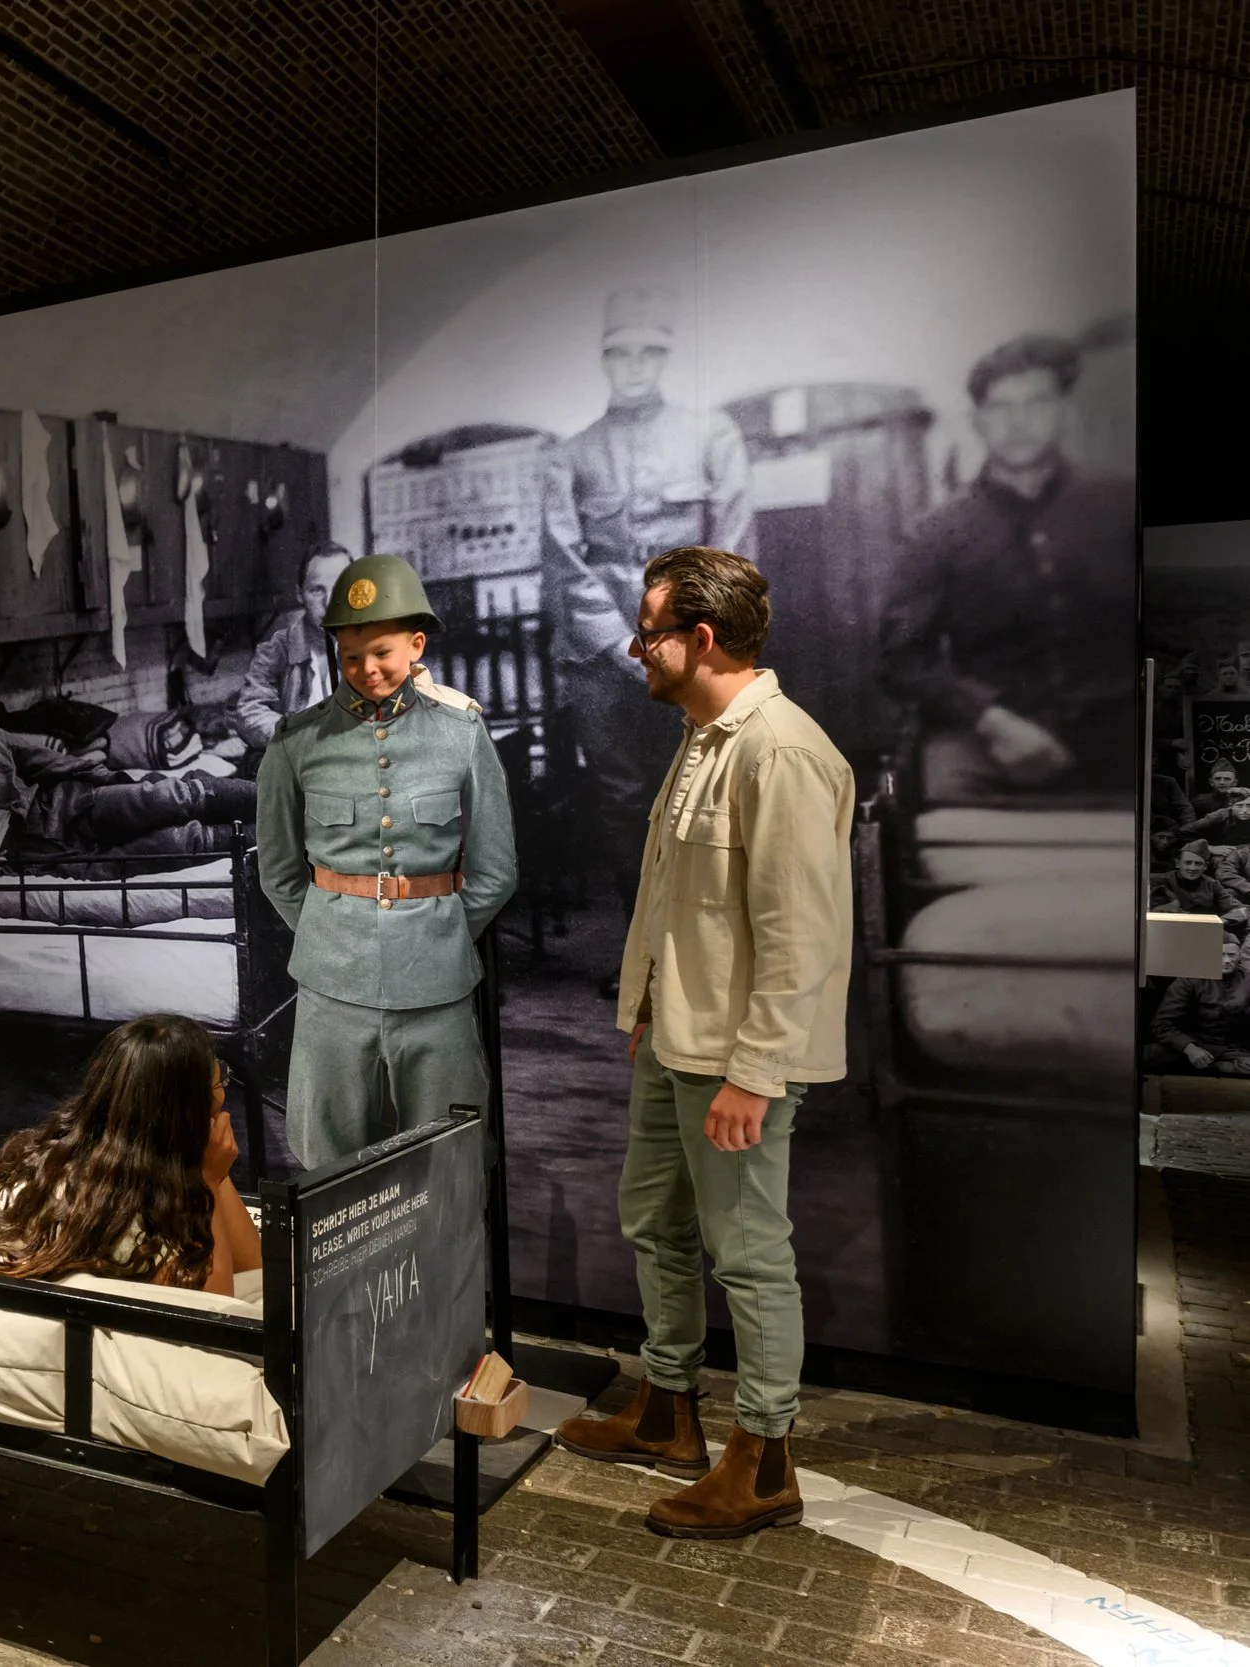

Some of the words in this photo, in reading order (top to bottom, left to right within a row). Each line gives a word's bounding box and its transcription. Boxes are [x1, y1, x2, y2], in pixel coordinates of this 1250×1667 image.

[312, 1208, 348, 1238] SCHRIJF
[348, 1200, 367, 1220] HIER
[368, 1194, 378, 1210] JE
[379, 1183, 401, 1204] NAAM
[346, 1220, 370, 1244] WRITE
[371, 1210, 390, 1231] YOUR
[391, 1200, 410, 1222] NAME
[411, 1190, 429, 1211] HERE
[312, 1253, 350, 1287] SCHREIBE
[350, 1244, 368, 1266] HIER
[369, 1232, 394, 1256] DEINEN
[394, 1217, 417, 1242] NAMEN
